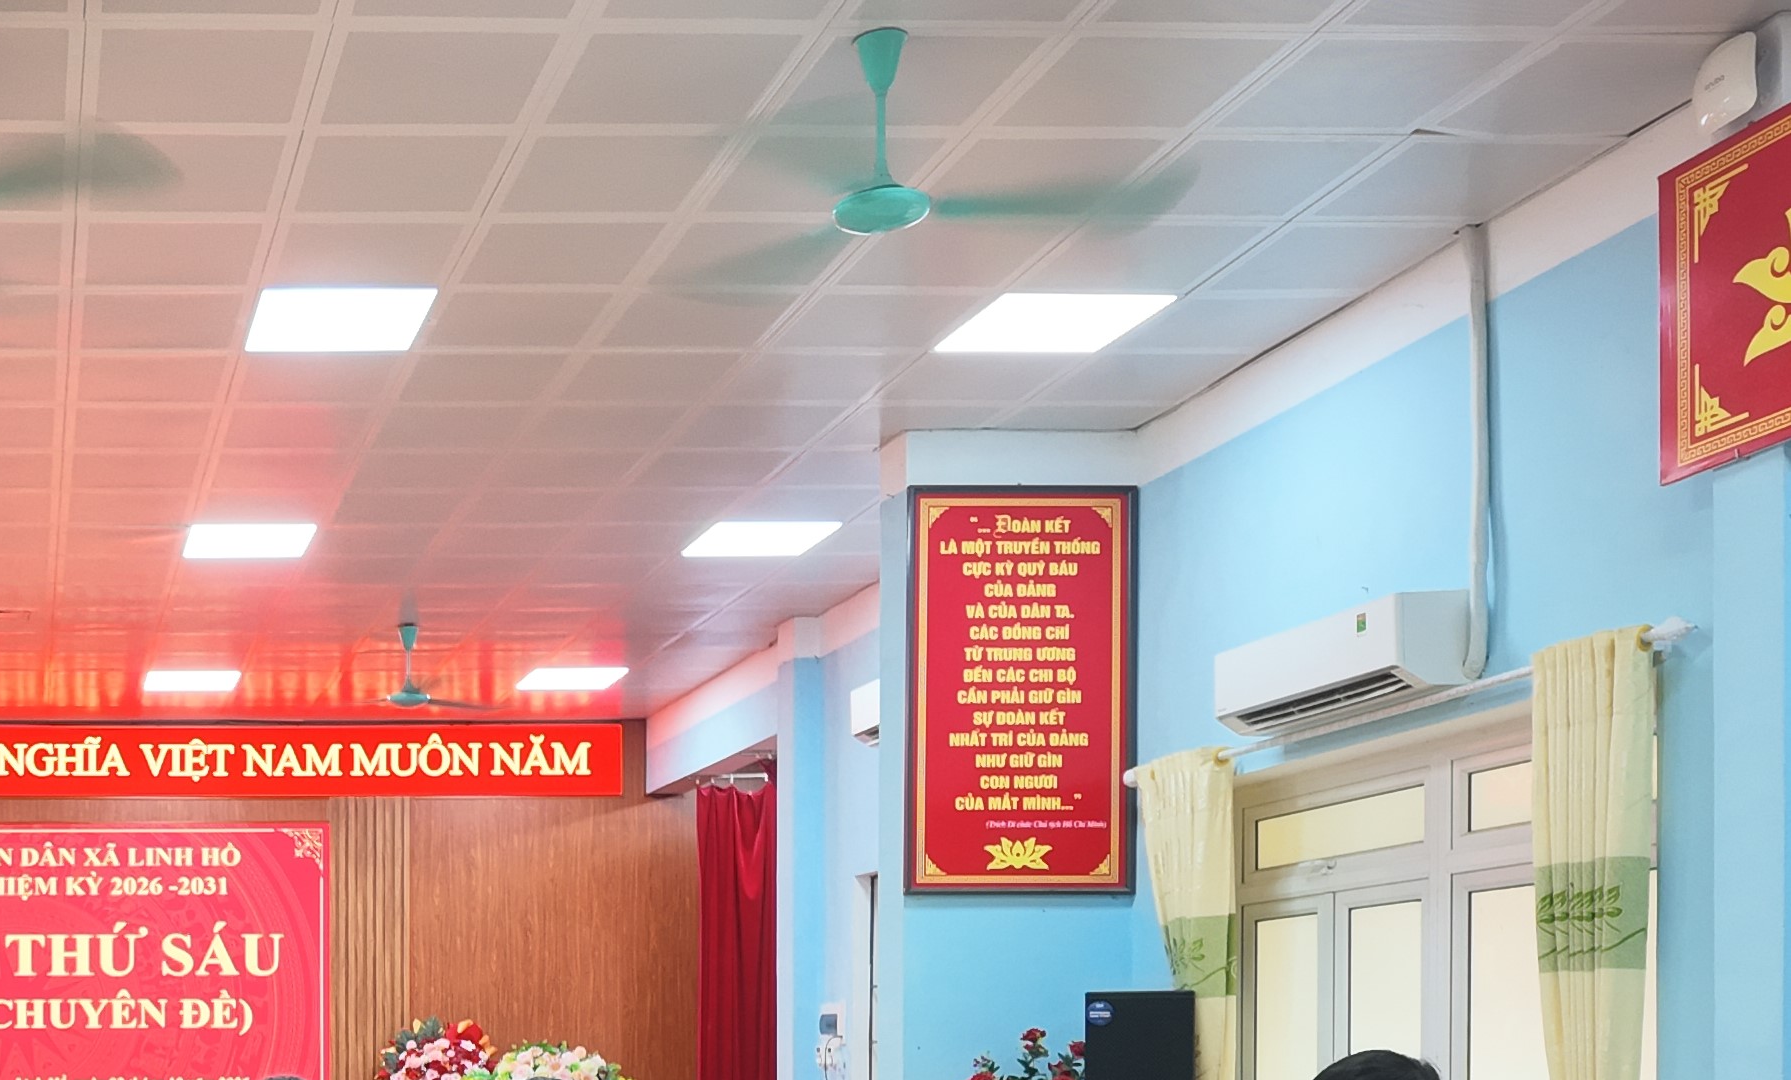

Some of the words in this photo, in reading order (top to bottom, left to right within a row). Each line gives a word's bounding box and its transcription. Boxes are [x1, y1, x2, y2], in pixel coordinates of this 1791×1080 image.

[993, 514, 1041, 538] ĐOÀN
[1045, 516, 1071, 533] KẾT
[940, 538, 958, 554] LÀ
[961, 539, 992, 557] MỘT
[996, 537, 1050, 554] TRUYỀN
[1054, 537, 1100, 554] THỐNG
[963, 561, 991, 579] CỰC
[995, 560, 1013, 576] KỲ
[1049, 560, 1078, 576] BÁU
[984, 580, 1013, 597] CỦA
[1017, 580, 1056, 597] ĐẢNG
[966, 602, 985, 618] VÀ
[988, 601, 1017, 618] CỦA
[1021, 602, 1050, 618] DÂN
[1054, 605, 1074, 618] TA.
[969, 624, 998, 640] CÁC
[1002, 622, 1041, 640] ĐỒNG
[1045, 624, 1070, 640] CHÍ
[964, 646, 983, 661] TỪ
[986, 647, 1032, 661] TRUNG
[1036, 647, 1075, 661] ƯƠNG
[963, 665, 992, 683] ĐẾN
[996, 667, 1025, 683] CÁC
[1029, 669, 1053, 683] CHI
[1057, 666, 1077, 685] BỘ
[957, 686, 987, 704] CẦN
[991, 686, 1024, 704] PHẢI
[1029, 688, 1054, 704] GIỮ
[1056, 688, 1081, 704] GÌN
[973, 710, 994, 728] SỰ
[996, 709, 1035, 725] ĐOÀN
[1039, 707, 1066, 725] KẾT
[949, 728, 987, 747] NHẤT
[991, 730, 1013, 747] TRÍ
[1017, 729, 1046, 747] CỦA
[1049, 729, 1089, 747] ĐẢNG
[140, 739, 235, 782] VIỆT
[242, 742, 343, 778] NAM
[350, 732, 485, 777] MUÔN
[491, 733, 592, 776] NĂM
[975, 753, 1007, 768] NHƯ
[1010, 752, 1035, 768] GIỮ
[1037, 752, 1062, 768] GÌN
[980, 775, 1009, 789] CON
[1013, 774, 1058, 789] NGƯƠI
[955, 793, 984, 810] CỦA
[988, 792, 1019, 810] MẮT
[20, 843, 78, 867] DÂN
[83, 843, 121, 867] XÃ
[128, 847, 194, 867] LINH
[201, 842, 242, 867] HỒ
[65, 873, 105, 897] KỲ
[111, 876, 163, 896] 2026
[169, 876, 228, 896] -2031
[5, 920, 149, 977] THỨ
[161, 920, 285, 978] SÁU
[179, 988, 253, 1036] ĐỀ)
